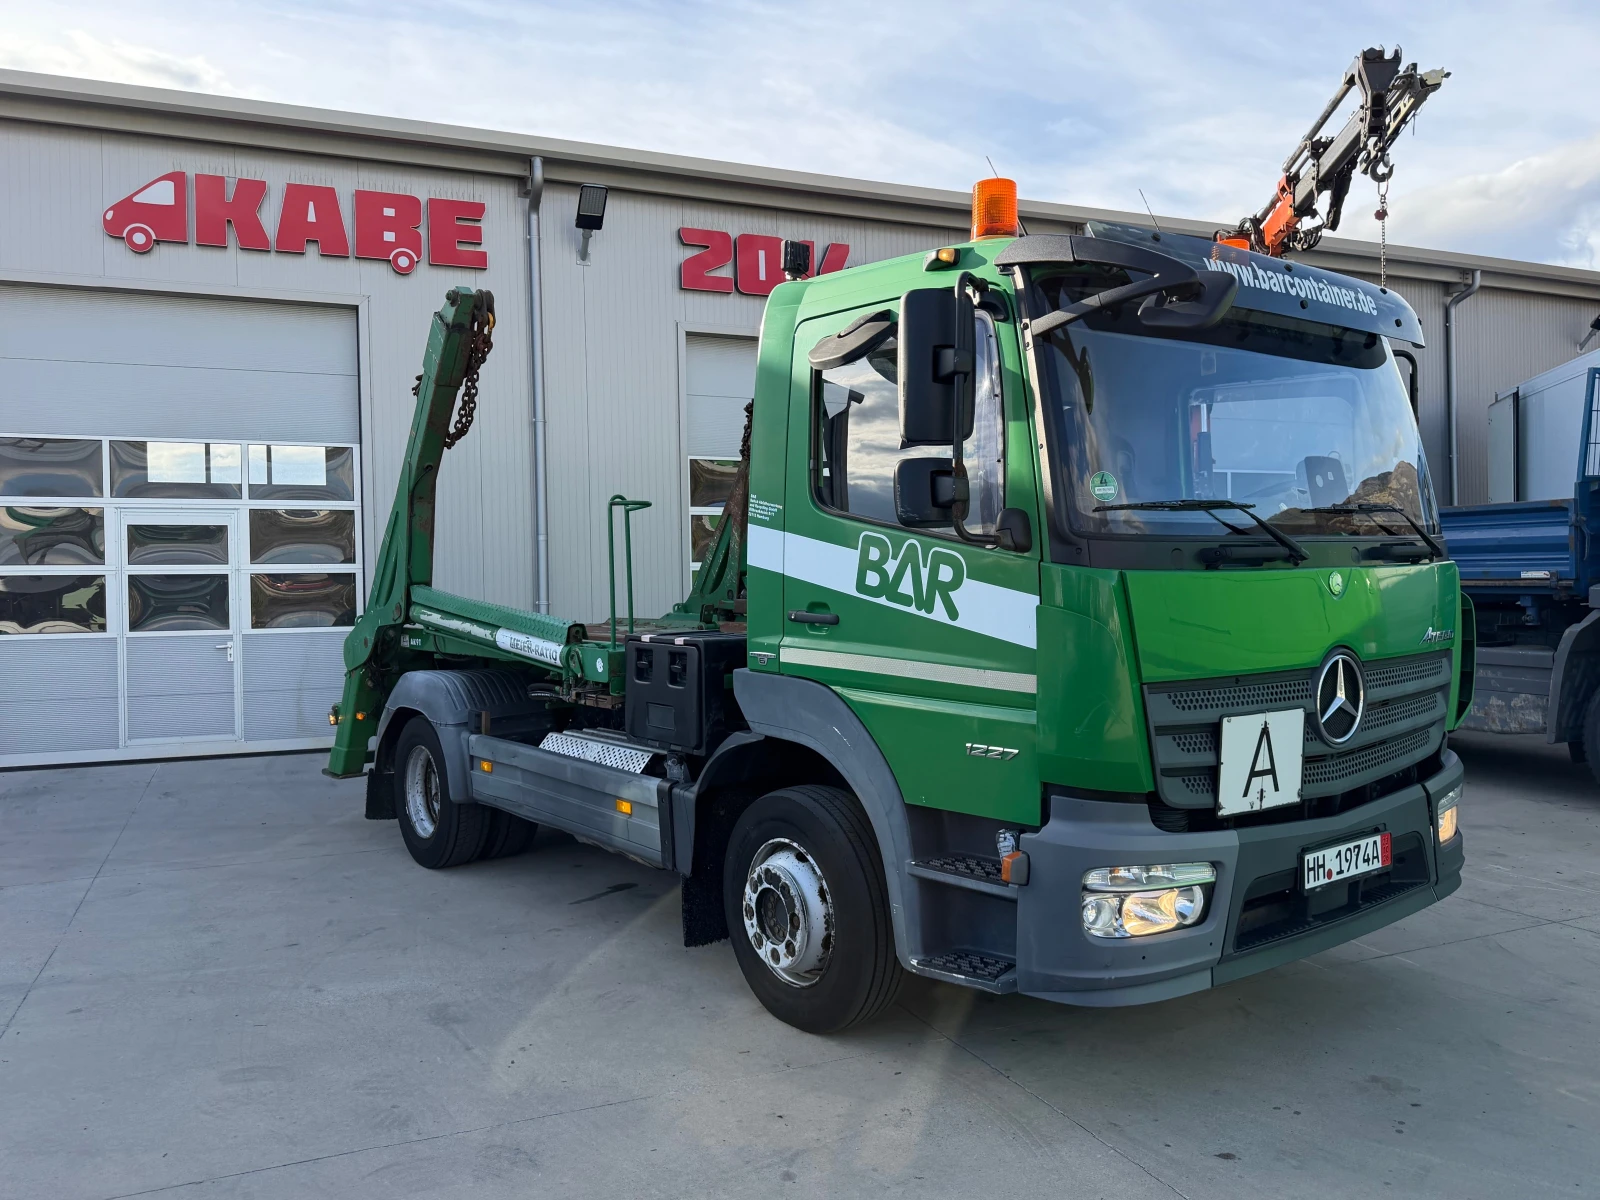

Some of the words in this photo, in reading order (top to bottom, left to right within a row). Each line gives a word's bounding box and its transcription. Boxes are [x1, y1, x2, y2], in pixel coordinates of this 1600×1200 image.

[194, 173, 489, 274] KABE
[855, 531, 967, 622] BAR
[965, 743, 1020, 761] 1227
[1242, 725, 1279, 798] A
[1306, 853, 1326, 884] HH
[1335, 840, 1380, 875] 1974A
